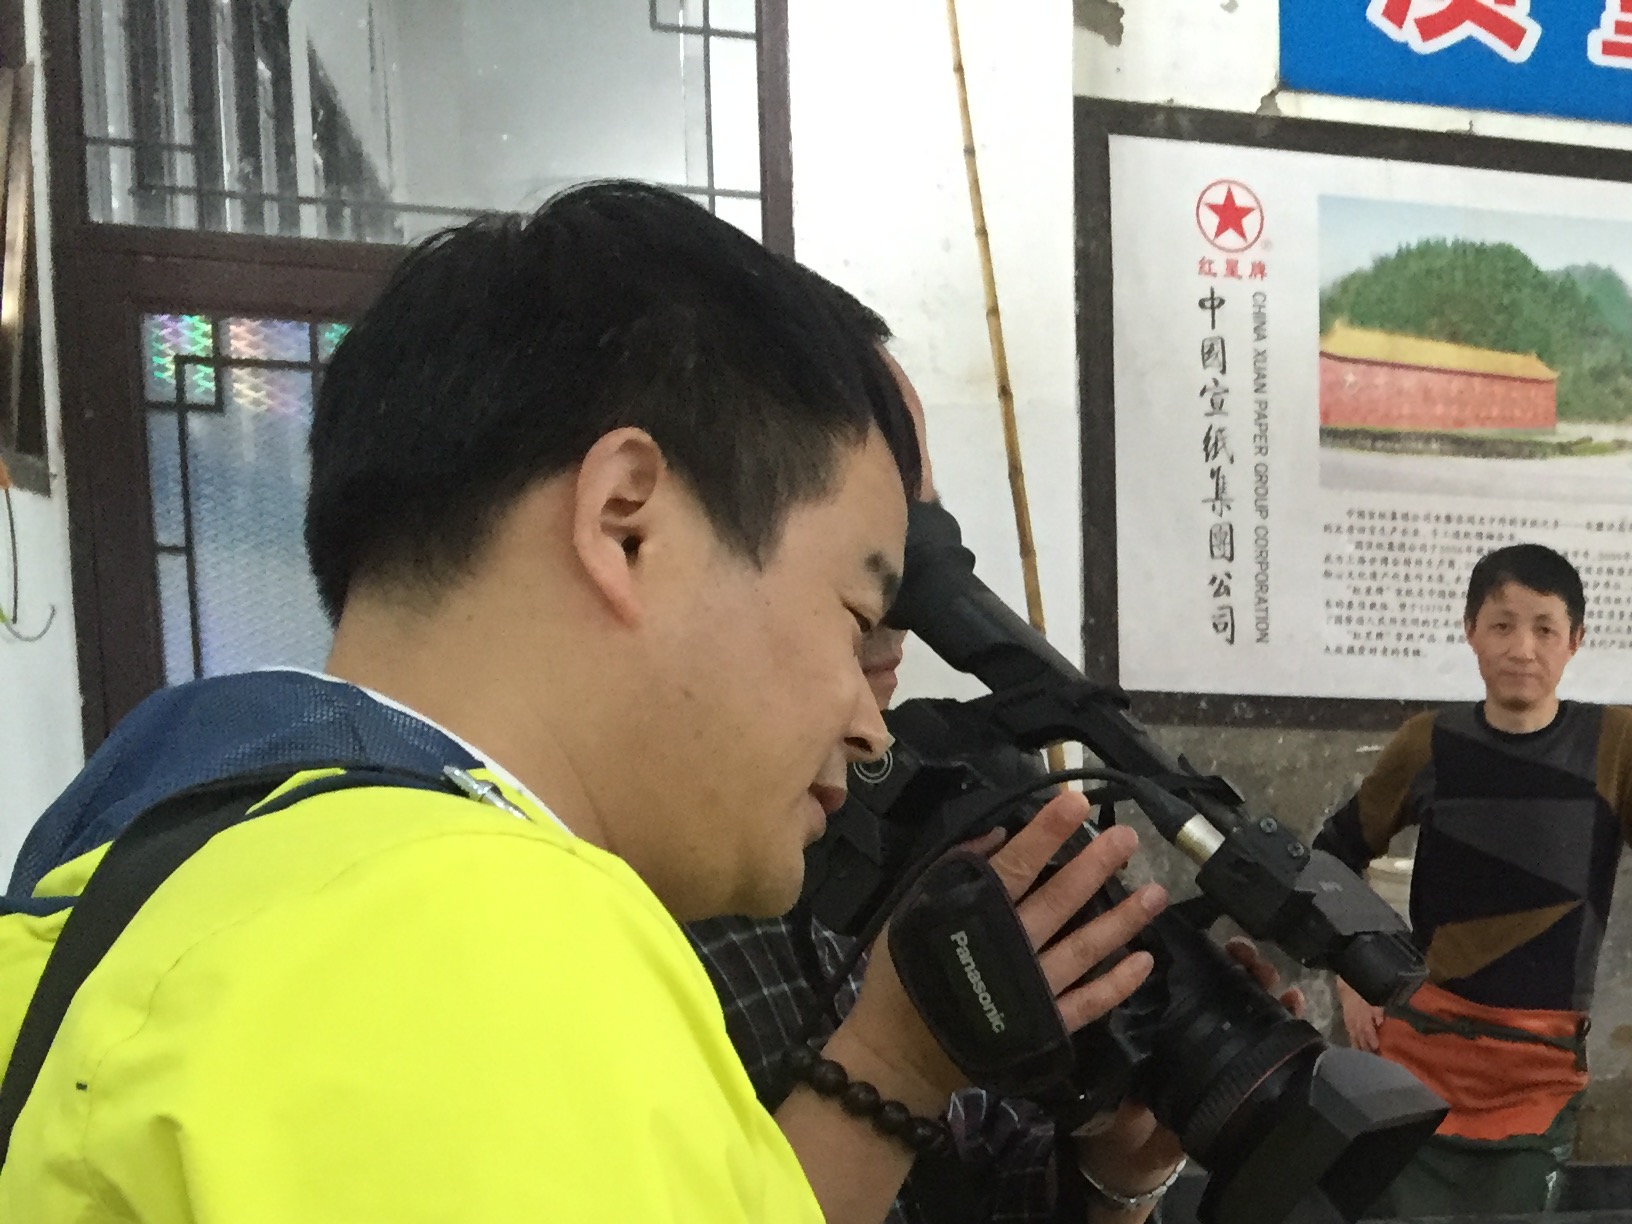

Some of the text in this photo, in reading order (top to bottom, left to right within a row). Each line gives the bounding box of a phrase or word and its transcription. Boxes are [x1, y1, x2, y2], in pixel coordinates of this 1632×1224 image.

[1252, 291, 1270, 644] CHINA XUAN PAPER GROUP CORPORATION
[950, 930, 1006, 1034] Panasonic
